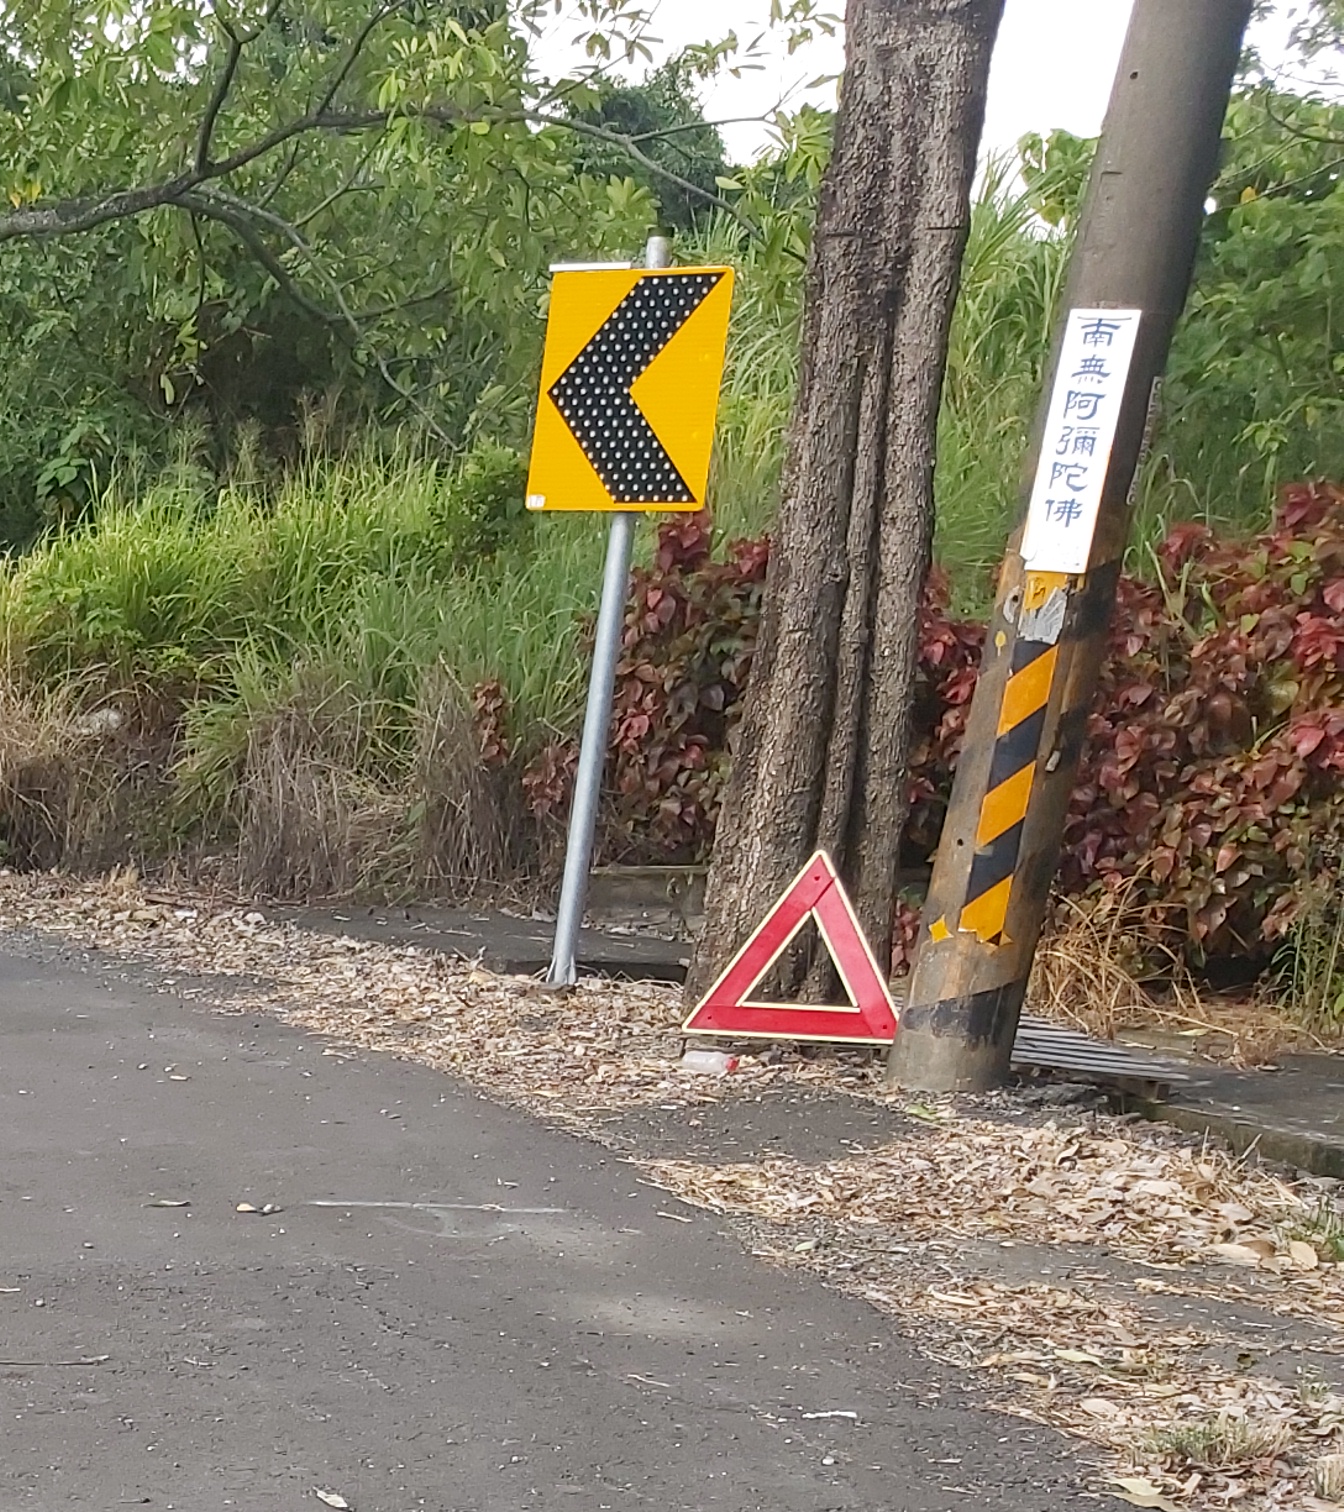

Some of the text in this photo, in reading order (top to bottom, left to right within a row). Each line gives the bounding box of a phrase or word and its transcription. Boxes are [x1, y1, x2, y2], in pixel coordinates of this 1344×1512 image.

[1044, 317, 1123, 528] 南無阿彌陀佛
